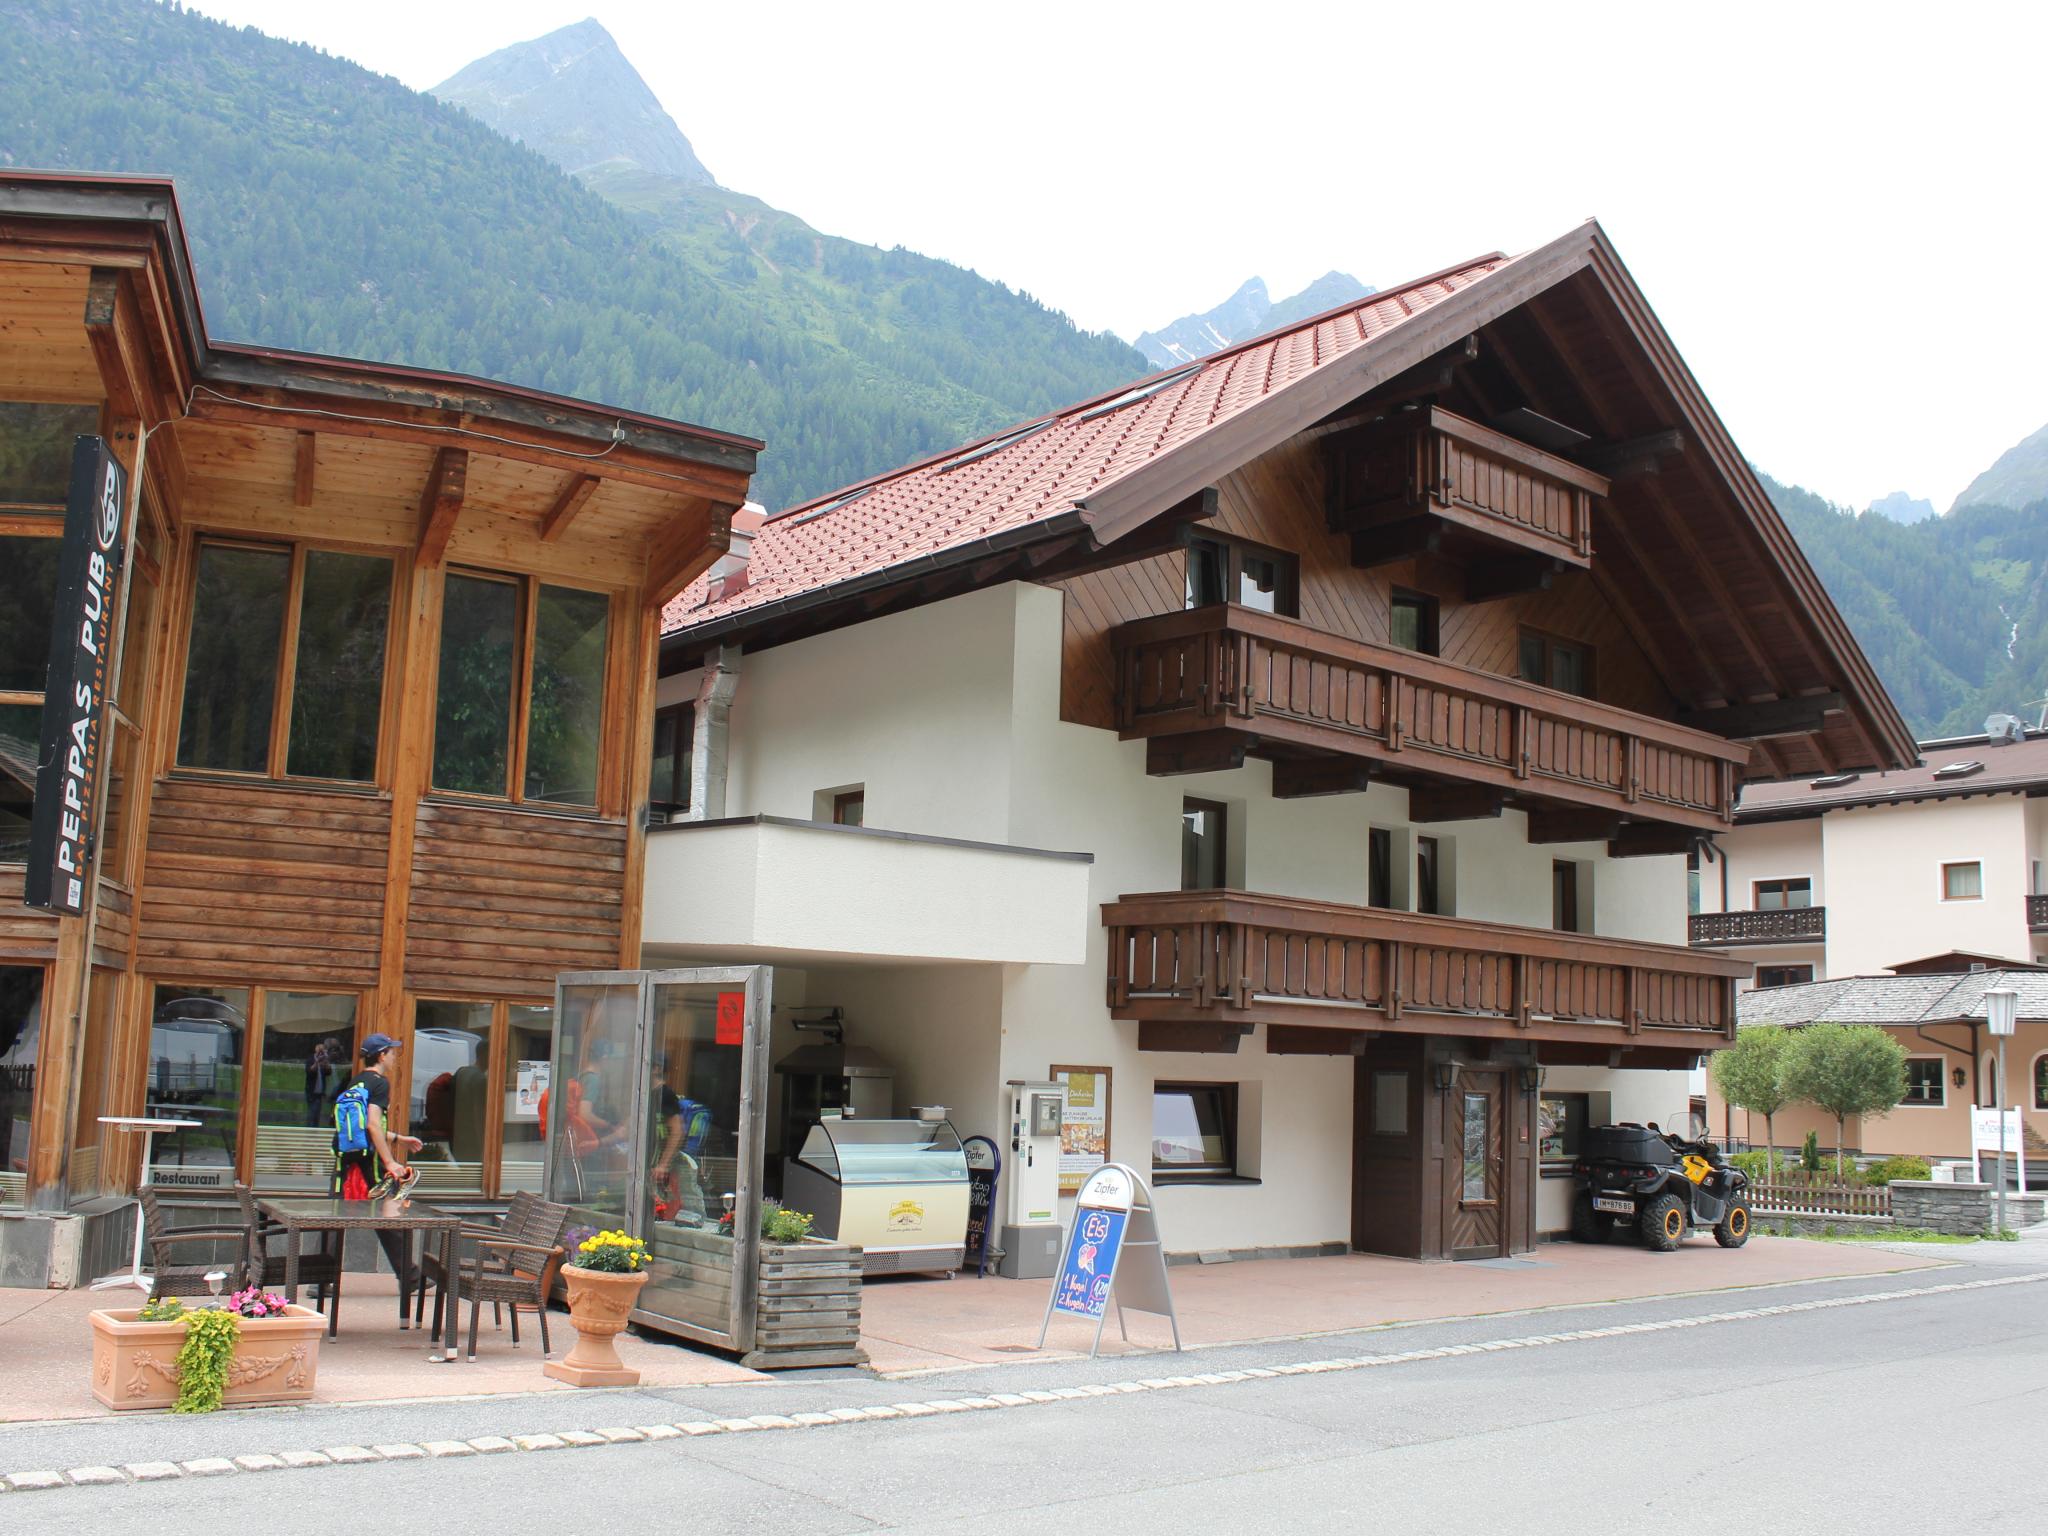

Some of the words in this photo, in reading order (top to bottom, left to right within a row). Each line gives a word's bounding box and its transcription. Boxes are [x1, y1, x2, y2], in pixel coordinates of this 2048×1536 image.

[58, 680, 91, 873] PEPPAS
[81, 551, 105, 656] PUB
[75, 833, 86, 877] BAR
[82, 719, 97, 822] PIZZERIA
[93, 562, 114, 707] RESTAURANT
[966, 1150, 985, 1161] Zipfer
[153, 1172, 220, 1185] Restaurant
[1094, 1182, 1119, 1195] Zipfer
